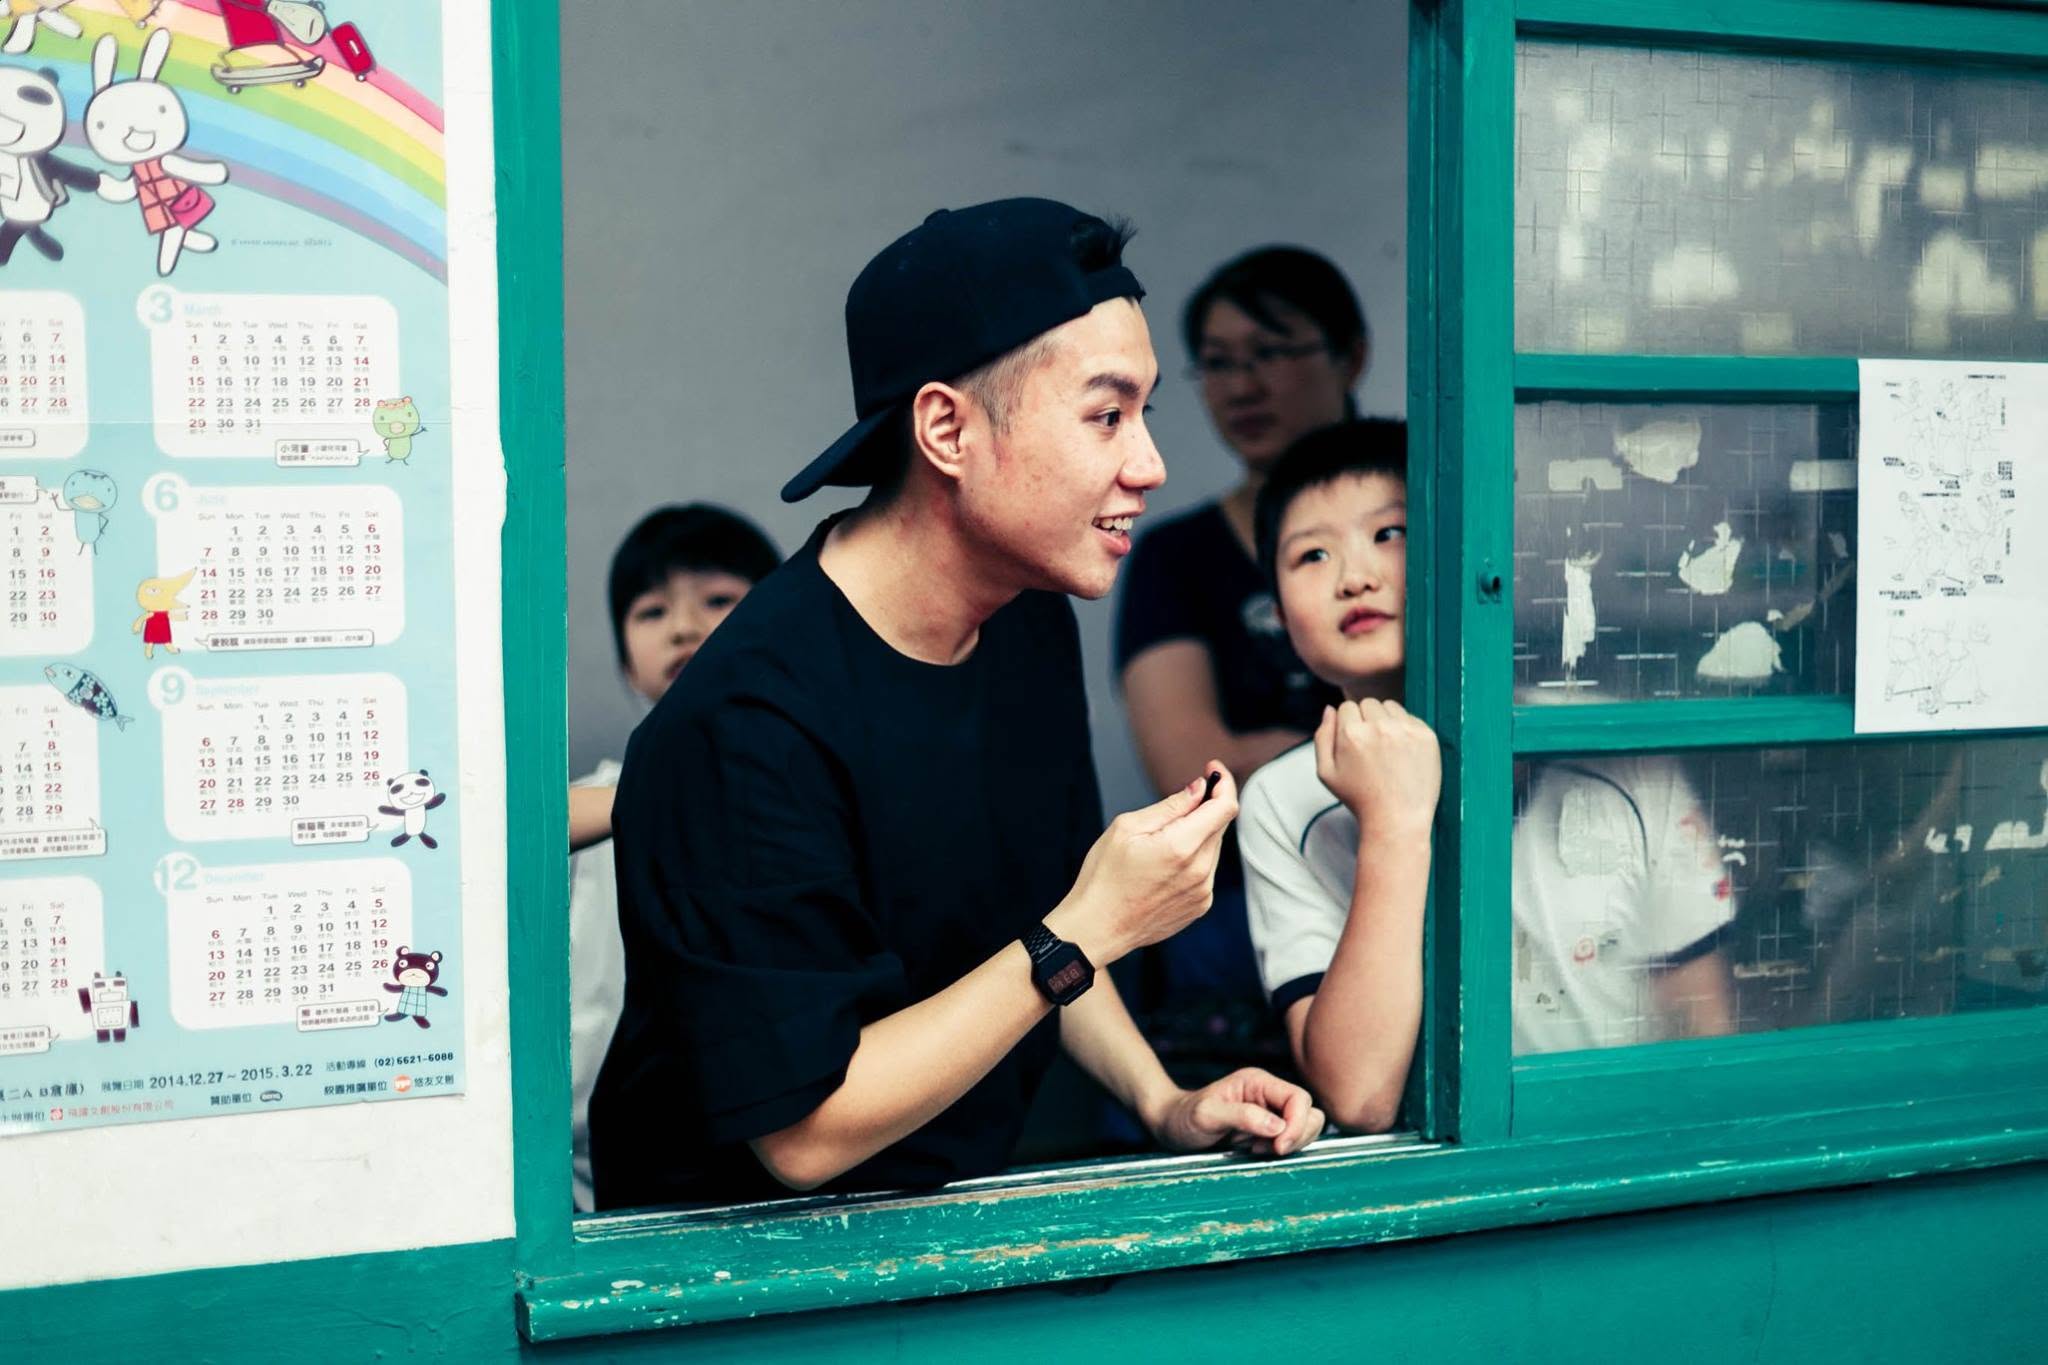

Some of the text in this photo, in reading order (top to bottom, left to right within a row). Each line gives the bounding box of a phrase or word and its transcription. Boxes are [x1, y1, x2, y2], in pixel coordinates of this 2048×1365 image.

[150, 292, 174, 324] 3
[184, 302, 222, 316] March
[192, 334, 364, 345] 1 2 3 4 5 6 7
[191, 355, 369, 366] 8 9 10 11 12 13 14
[189, 376, 368, 387] 15 16 17 18 19 20 21
[188, 397, 371, 408] 22 23 24 25 26 27 28
[189, 418, 261, 428] 29 30 31
[154, 479, 179, 512] 6
[232, 524, 376, 535] 1 2 3 4 5 6
[204, 544, 381, 557] 7 8 9 10 11 12 13
[201, 565, 381, 578] 14 15 16 17 18 19 20
[201, 585, 381, 599] 21 22 23 24 25 26 27
[201, 608, 274, 620] 28 29 30
[160, 672, 186, 705] 9
[258, 710, 374, 724] 1 2 3 4 5
[202, 730, 379, 747] 6 7 8 9 10 11 12
[200, 750, 379, 768] 13 14 15 16 17 18 19
[199, 770, 380, 789] 20 21 22 23 24 25 26
[200, 795, 300, 810] 27 28 29 30
[157, 858, 198, 891] 12
[267, 898, 383, 915] 1 2 3 4 5
[24, 915, 61, 927] 6 7
[211, 918, 387, 940] 6 7 8 9 10 11 12
[22, 936, 67, 948] 13 14
[209, 939, 388, 960] 13 14 15 16 17 18 19
[21, 958, 66, 970] 20 21
[208, 959, 388, 981] 20 21 22 23 24 25 26
[51, 978, 68, 989] 28
[209, 983, 334, 1002] 27 28 29 30 31
[150, 1071, 224, 1089] 2014.12.27
[241, 1063, 313, 1082] 2015.3.22
